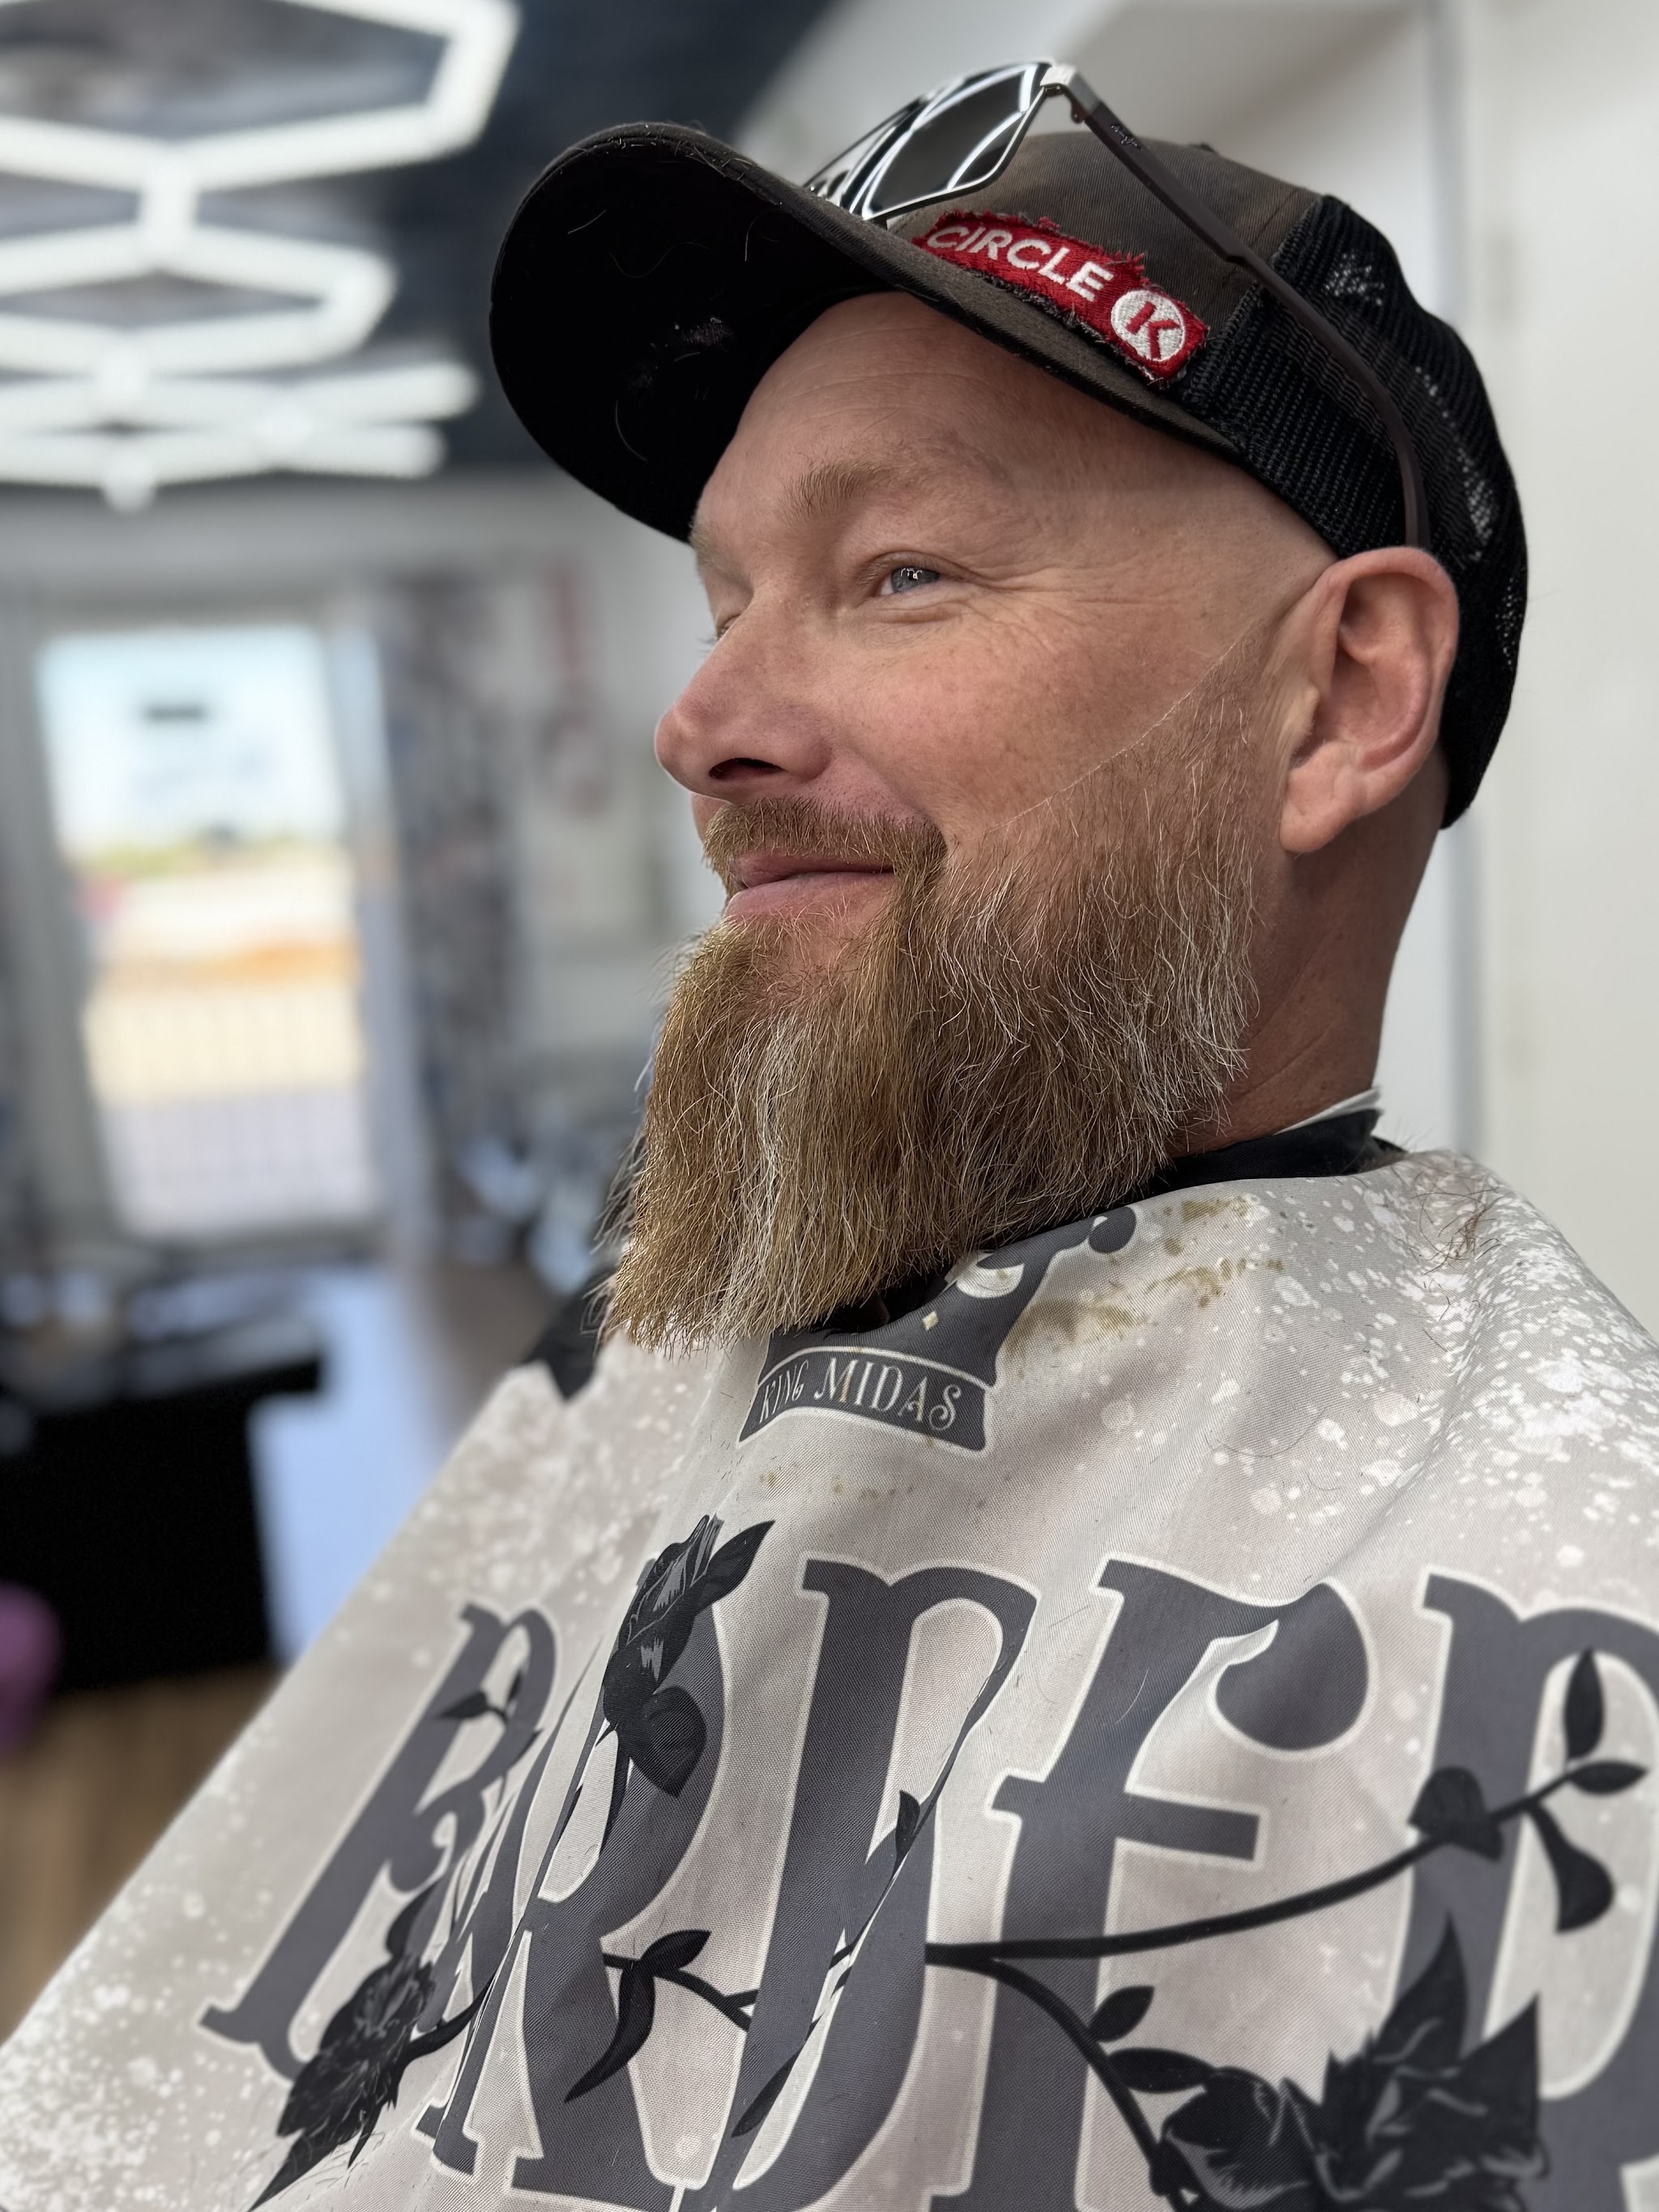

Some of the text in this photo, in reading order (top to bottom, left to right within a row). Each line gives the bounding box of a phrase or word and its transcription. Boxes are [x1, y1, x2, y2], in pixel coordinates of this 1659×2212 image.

[927, 226, 1179, 359] CIRCLE K
[759, 1357, 962, 1431] KING MIDAS
